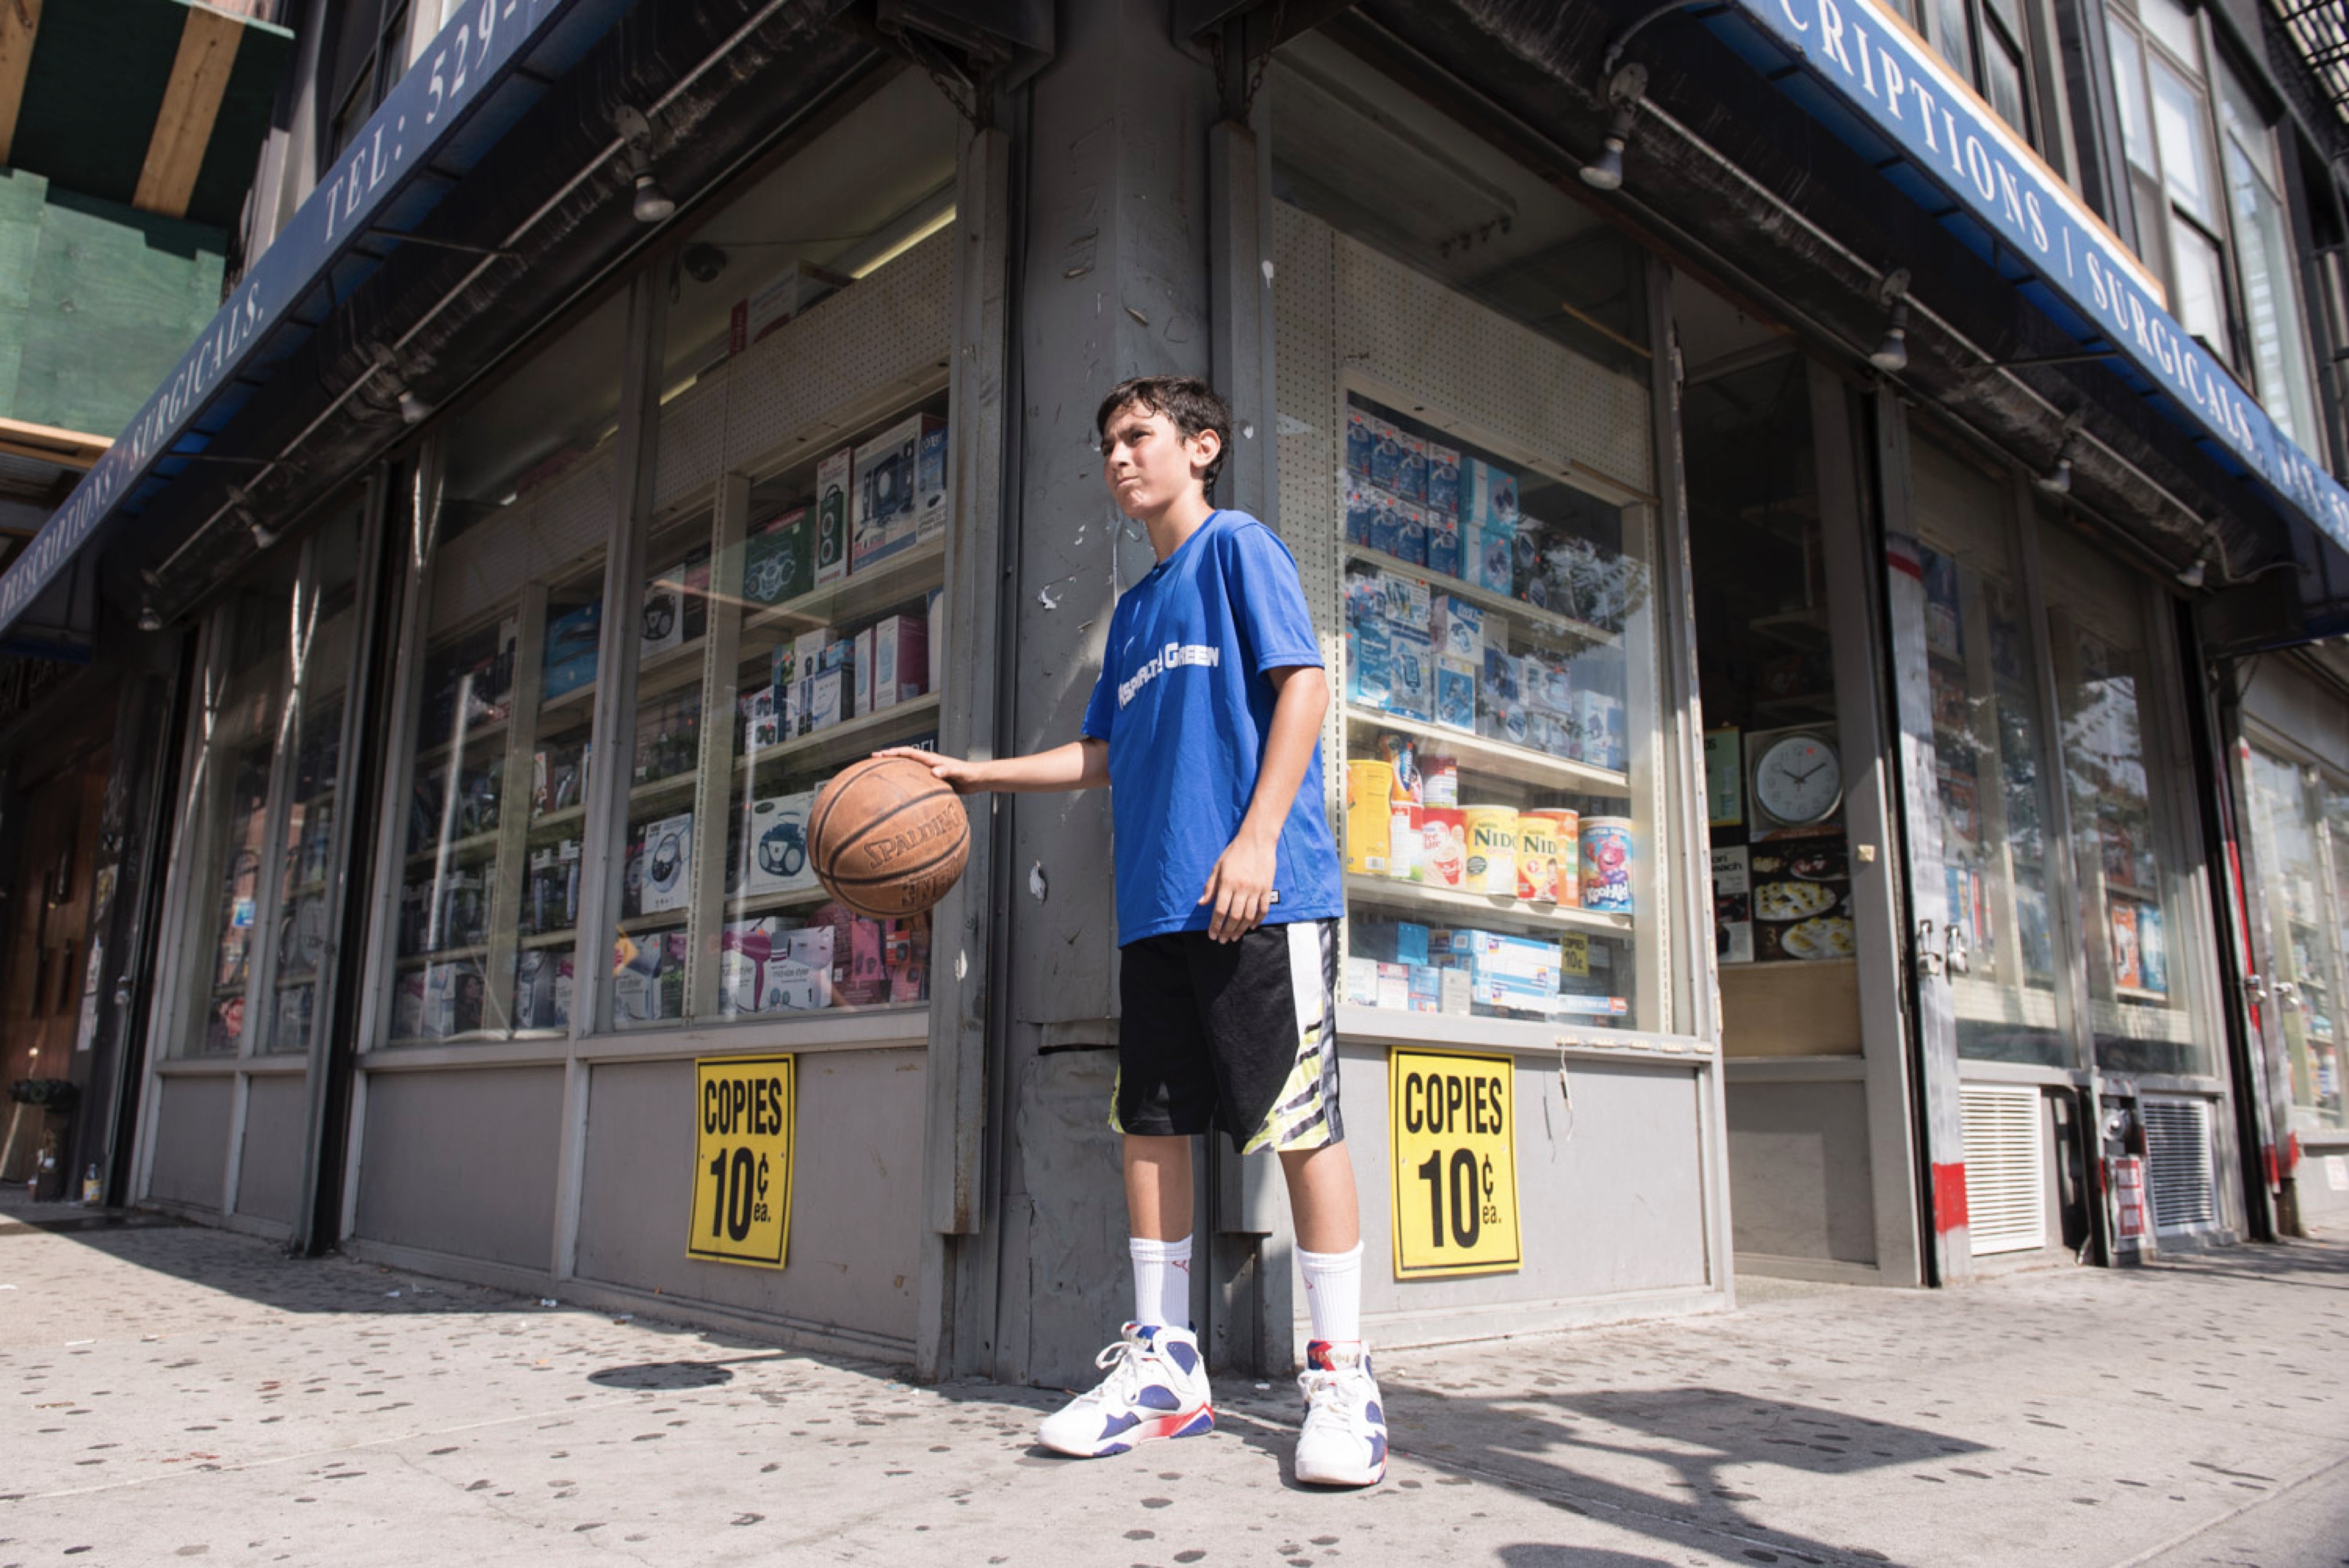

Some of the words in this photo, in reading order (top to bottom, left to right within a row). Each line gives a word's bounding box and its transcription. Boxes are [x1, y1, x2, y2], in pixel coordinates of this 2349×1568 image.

[324, 114, 405, 244] TEL:
[425, 0, 537, 125] 529-
[1164, 642, 1219, 669] GREEN
[864, 802, 960, 868] SPALDING
[704, 1077, 782, 1135] COPIES
[1404, 1072, 1503, 1135] COPIES
[753, 1202, 771, 1222] ea.
[1482, 1205, 1502, 1225] ea.
